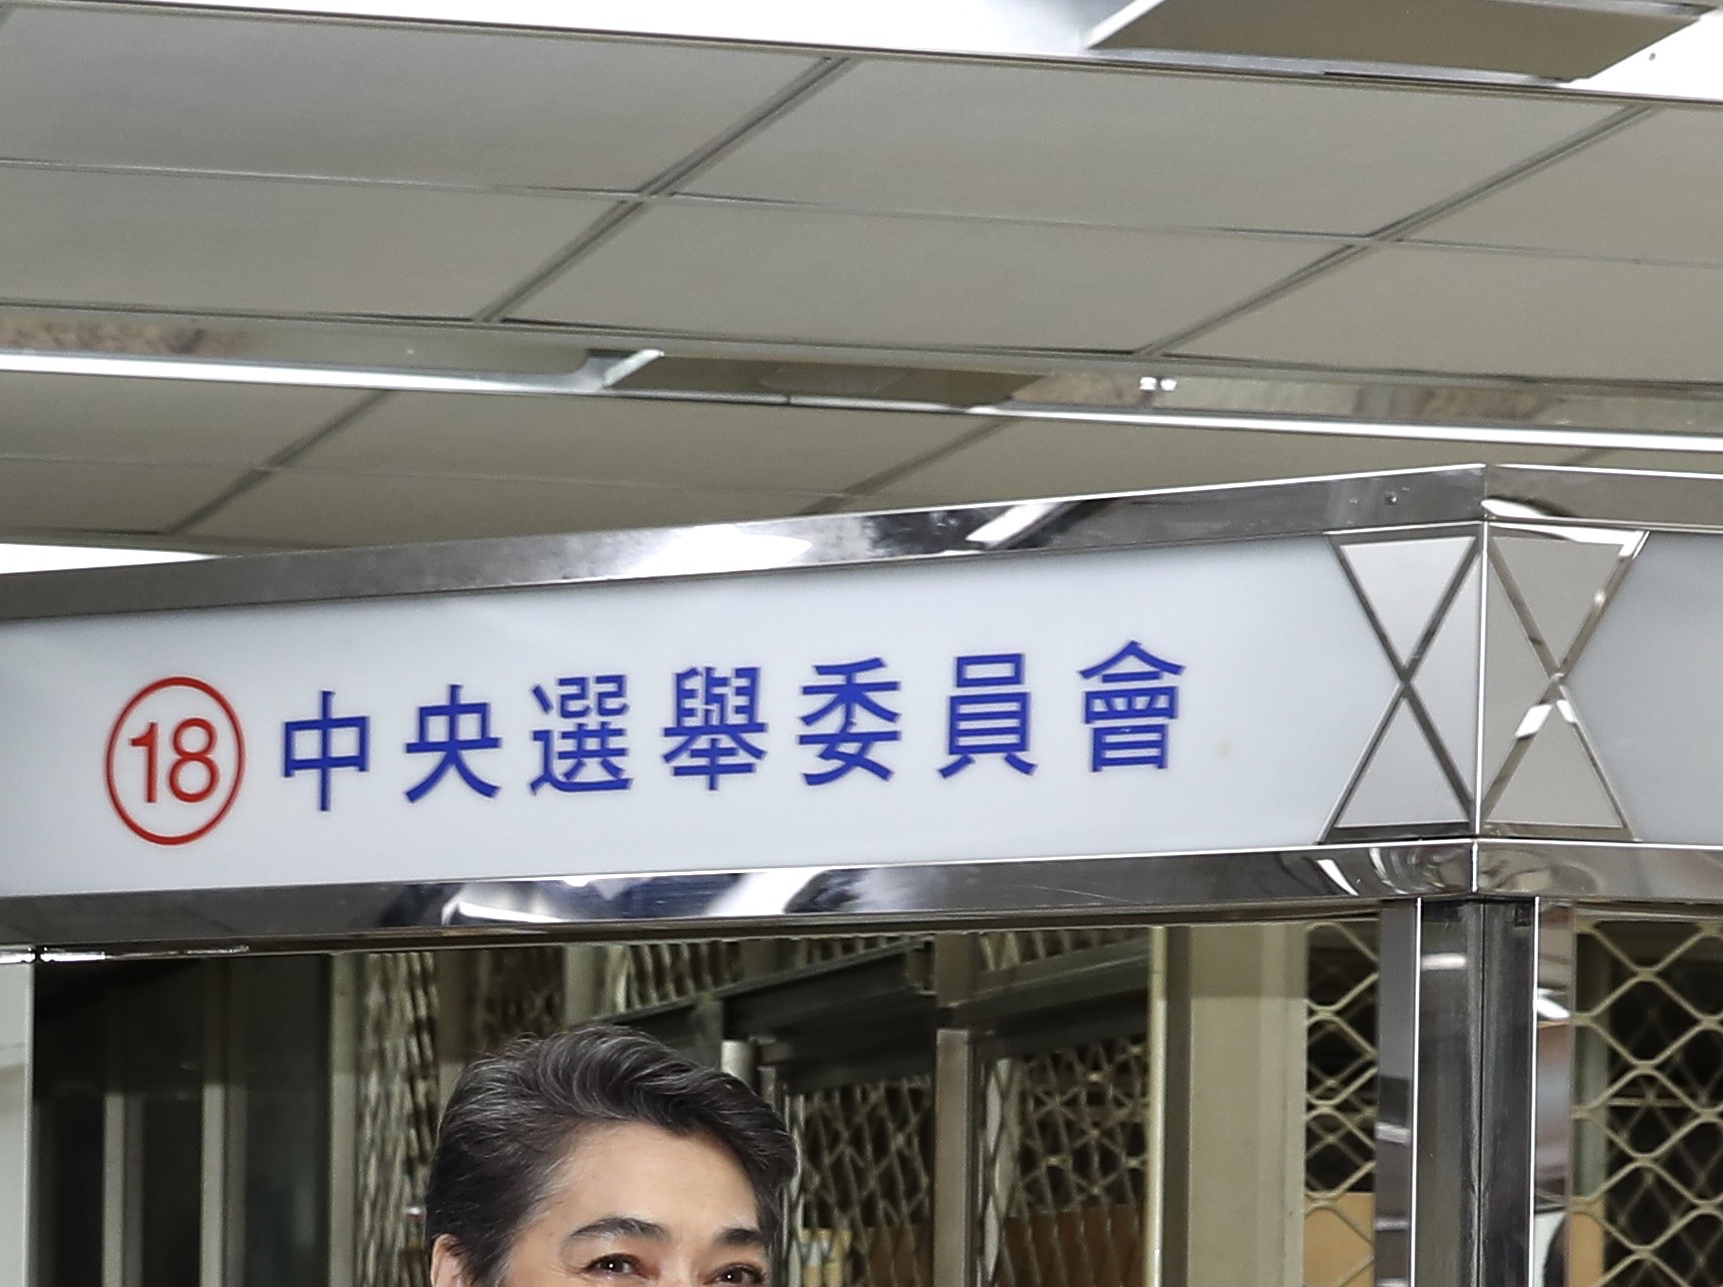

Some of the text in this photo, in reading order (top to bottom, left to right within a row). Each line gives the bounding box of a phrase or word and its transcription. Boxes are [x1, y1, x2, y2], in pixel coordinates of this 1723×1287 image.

[130, 640, 1185, 811] 18 中央選舉委員會
